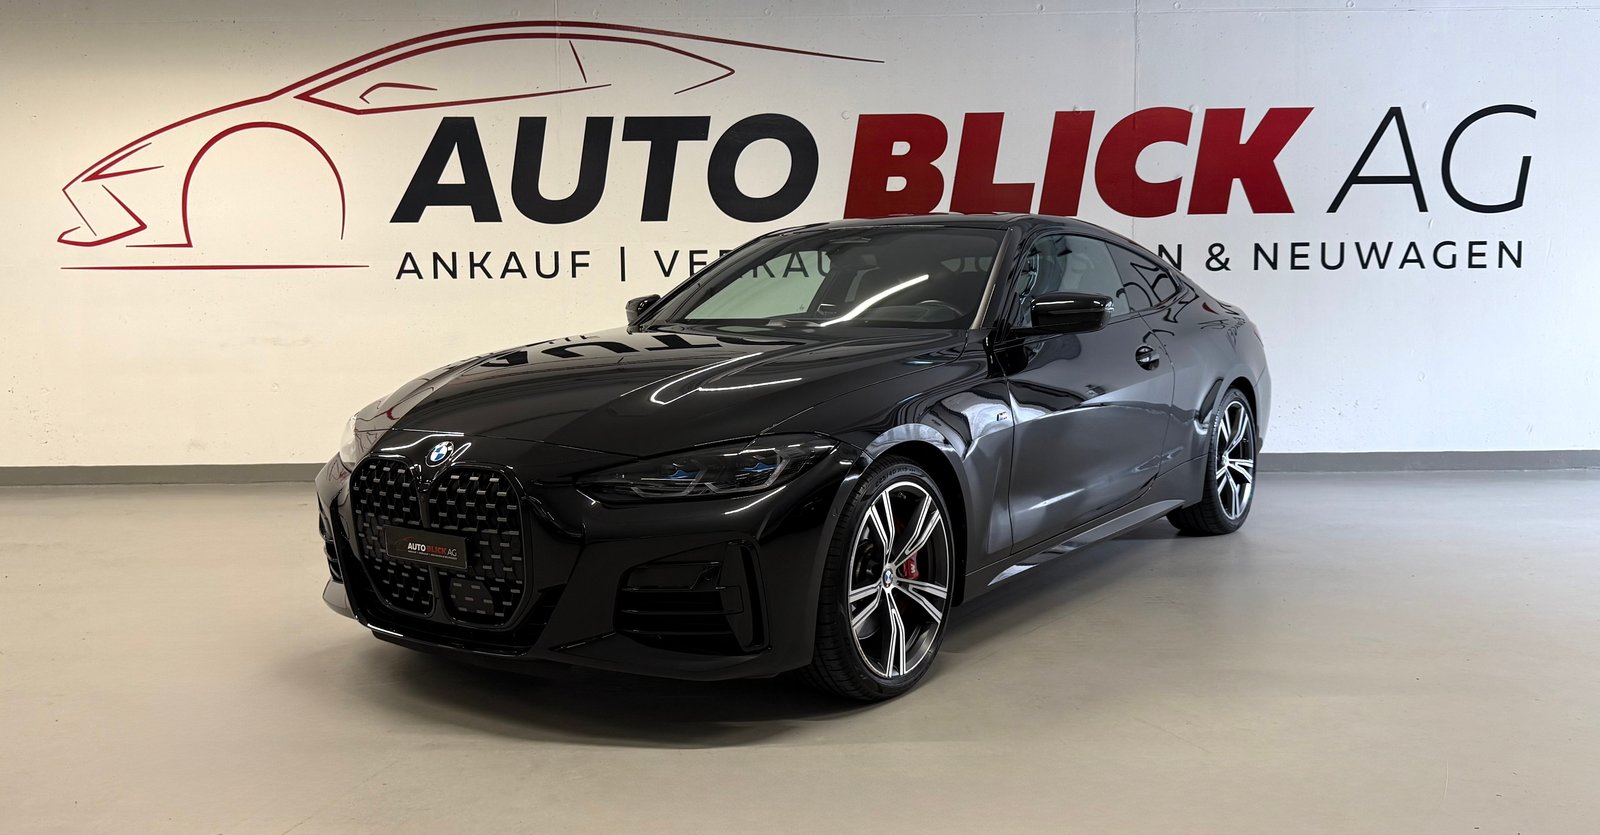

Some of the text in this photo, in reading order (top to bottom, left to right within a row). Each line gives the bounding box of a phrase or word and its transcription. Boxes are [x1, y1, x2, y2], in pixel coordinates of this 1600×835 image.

[388, 104, 1537, 224] AUTO BLICK AG
[396, 250, 590, 280] ANKAUF
[1253, 240, 1523, 271] NEUWAGEN
[407, 542, 426, 552] AUTO
[446, 548, 457, 557] AG
